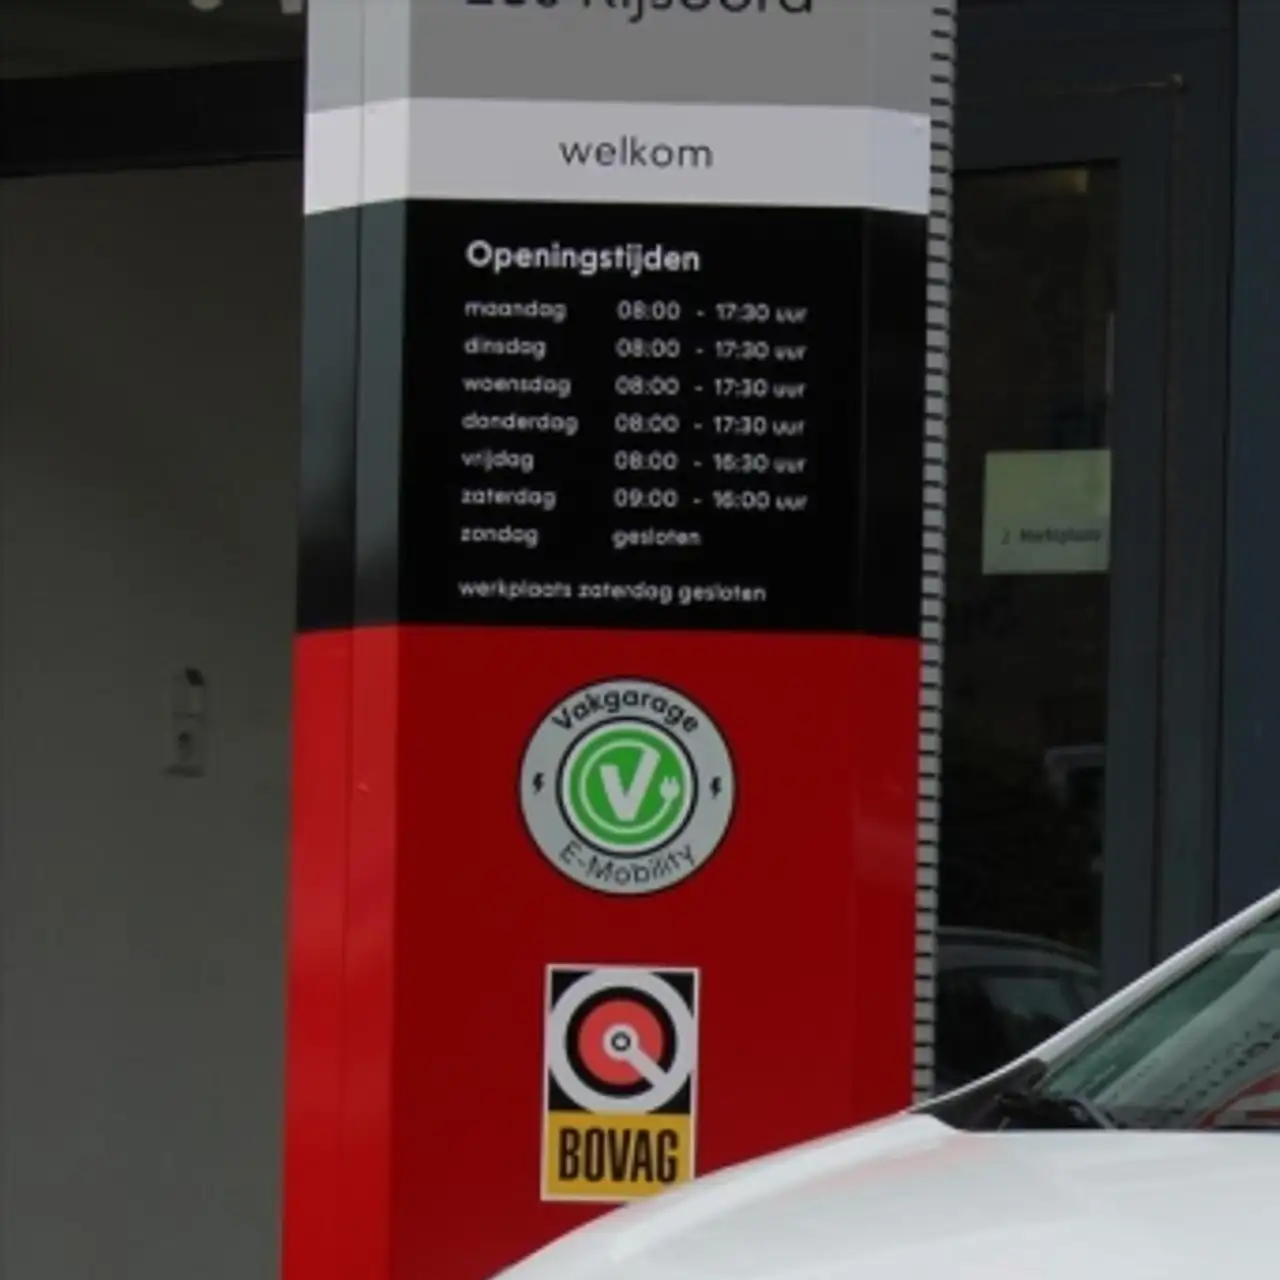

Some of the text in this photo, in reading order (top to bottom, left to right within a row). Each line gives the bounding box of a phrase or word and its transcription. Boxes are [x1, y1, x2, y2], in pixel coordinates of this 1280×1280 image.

[558, 135, 714, 170] welkom
[465, 239, 700, 278] Openingstijden
[464, 299, 567, 323] maandag
[616, 299, 682, 321] 08:00
[715, 301, 771, 323] 17:30
[775, 307, 808, 324] uur
[463, 336, 547, 361] dinsdag
[615, 336, 681, 359] 08:00
[715, 339, 770, 360] 17:30
[774, 345, 808, 361] uur
[462, 375, 572, 399] woensdag
[614, 374, 680, 396] 08:00
[714, 377, 769, 398] 17:30
[772, 382, 806, 399] uur
[461, 411, 579, 437] donderdag
[614, 412, 681, 434] 08:00
[713, 415, 768, 436] 17:30
[771, 419, 805, 437] uur
[460, 449, 535, 474] vrijdag
[614, 449, 680, 471] 08:00
[773, 457, 807, 474] uur
[461, 488, 557, 511] zaterdag
[613, 487, 679, 509] 09:00
[775, 495, 808, 512] uur
[460, 524, 701, 550] zondag gesloten
[458, 579, 767, 606] werkplaats zaterdag gesloten
[552, 689, 699, 732] Vakgarage
[559, 840, 697, 885] E-Mobility
[559, 1126, 679, 1183] BOVAG
